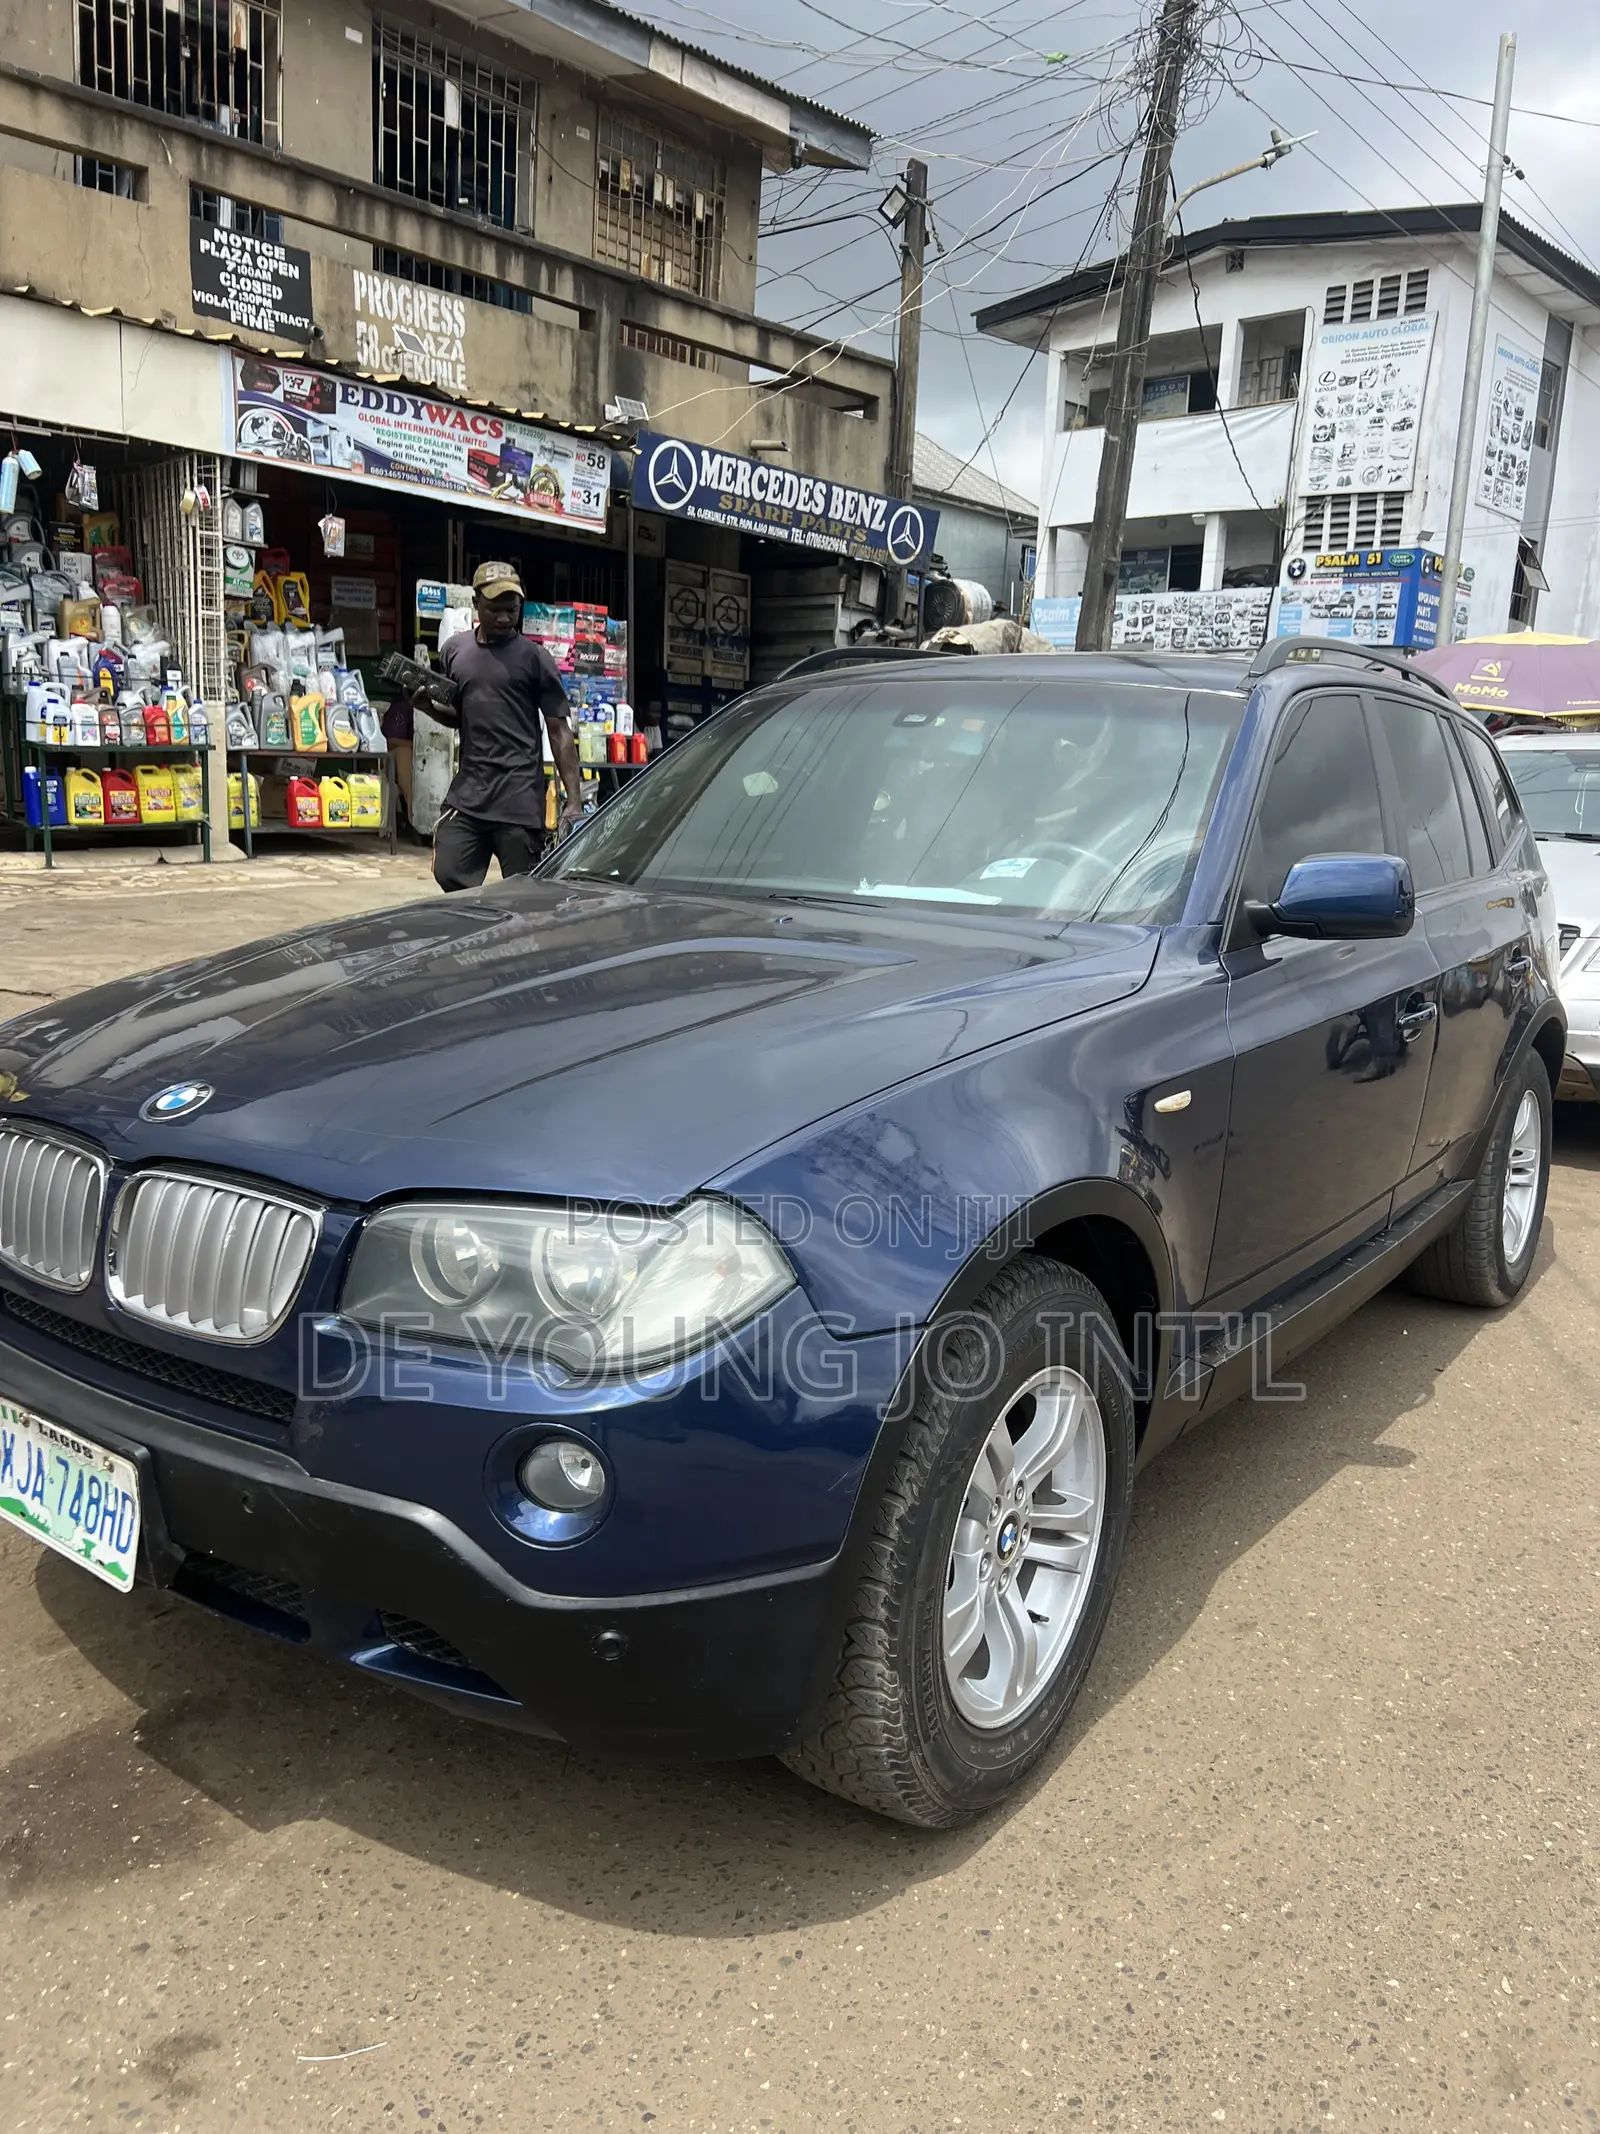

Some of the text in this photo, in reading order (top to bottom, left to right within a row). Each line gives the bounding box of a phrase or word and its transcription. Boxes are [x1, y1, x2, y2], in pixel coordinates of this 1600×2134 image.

[214, 228, 285, 260] NOTICE
[200, 239, 299, 279] PLAZA OPEN
[226, 260, 271, 282] 7:00AM
[220, 272, 283, 300] CLOSED
[228, 288, 272, 308] 7:30PM
[353, 269, 465, 338] PROGRESS
[193, 290, 309, 329] VIOLATION ATTRACT
[231, 310, 275, 332] FINE
[1321, 332, 1359, 344] OBIDON
[1361, 327, 1388, 339] AUTO
[1391, 322, 1430, 335] GLOBAL
[356, 320, 380, 369] 58
[340, 382, 504, 439] EDDYWACS
[358, 412, 487, 448] GLOBAL INTERNATIONAL LIMITED
[377, 438, 403, 449] Engine
[418, 446, 431, 455] Car
[431, 448, 464, 463] batteries,
[392, 450, 404, 459] Oil
[429, 458, 448, 469] Plugs
[575, 452, 606, 470] NO 58
[390, 462, 420, 474] CONTACT
[530, 492, 557, 507] ORIGINAL
[571, 490, 601, 507] NO 31
[700, 450, 888, 532] MERCEDES BENZ
[697, 507, 726, 524] OJEKUNLE
[739, 517, 753, 531] PAPA
[753, 521, 767, 534] AJAO
[767, 525, 788, 539] MUSHIN
[791, 527, 805, 544] TEL:
[718, 494, 867, 542] SPARE PARTS
[1315, 551, 1382, 568] PSALM 51
[485, 562, 512, 581] 99
[1034, 605, 1070, 623] Psalm
[580, 653, 599, 661] ROCKET
[1453, 682, 1509, 698] MoMo
[37, 1422, 94, 1460] LAGOS
